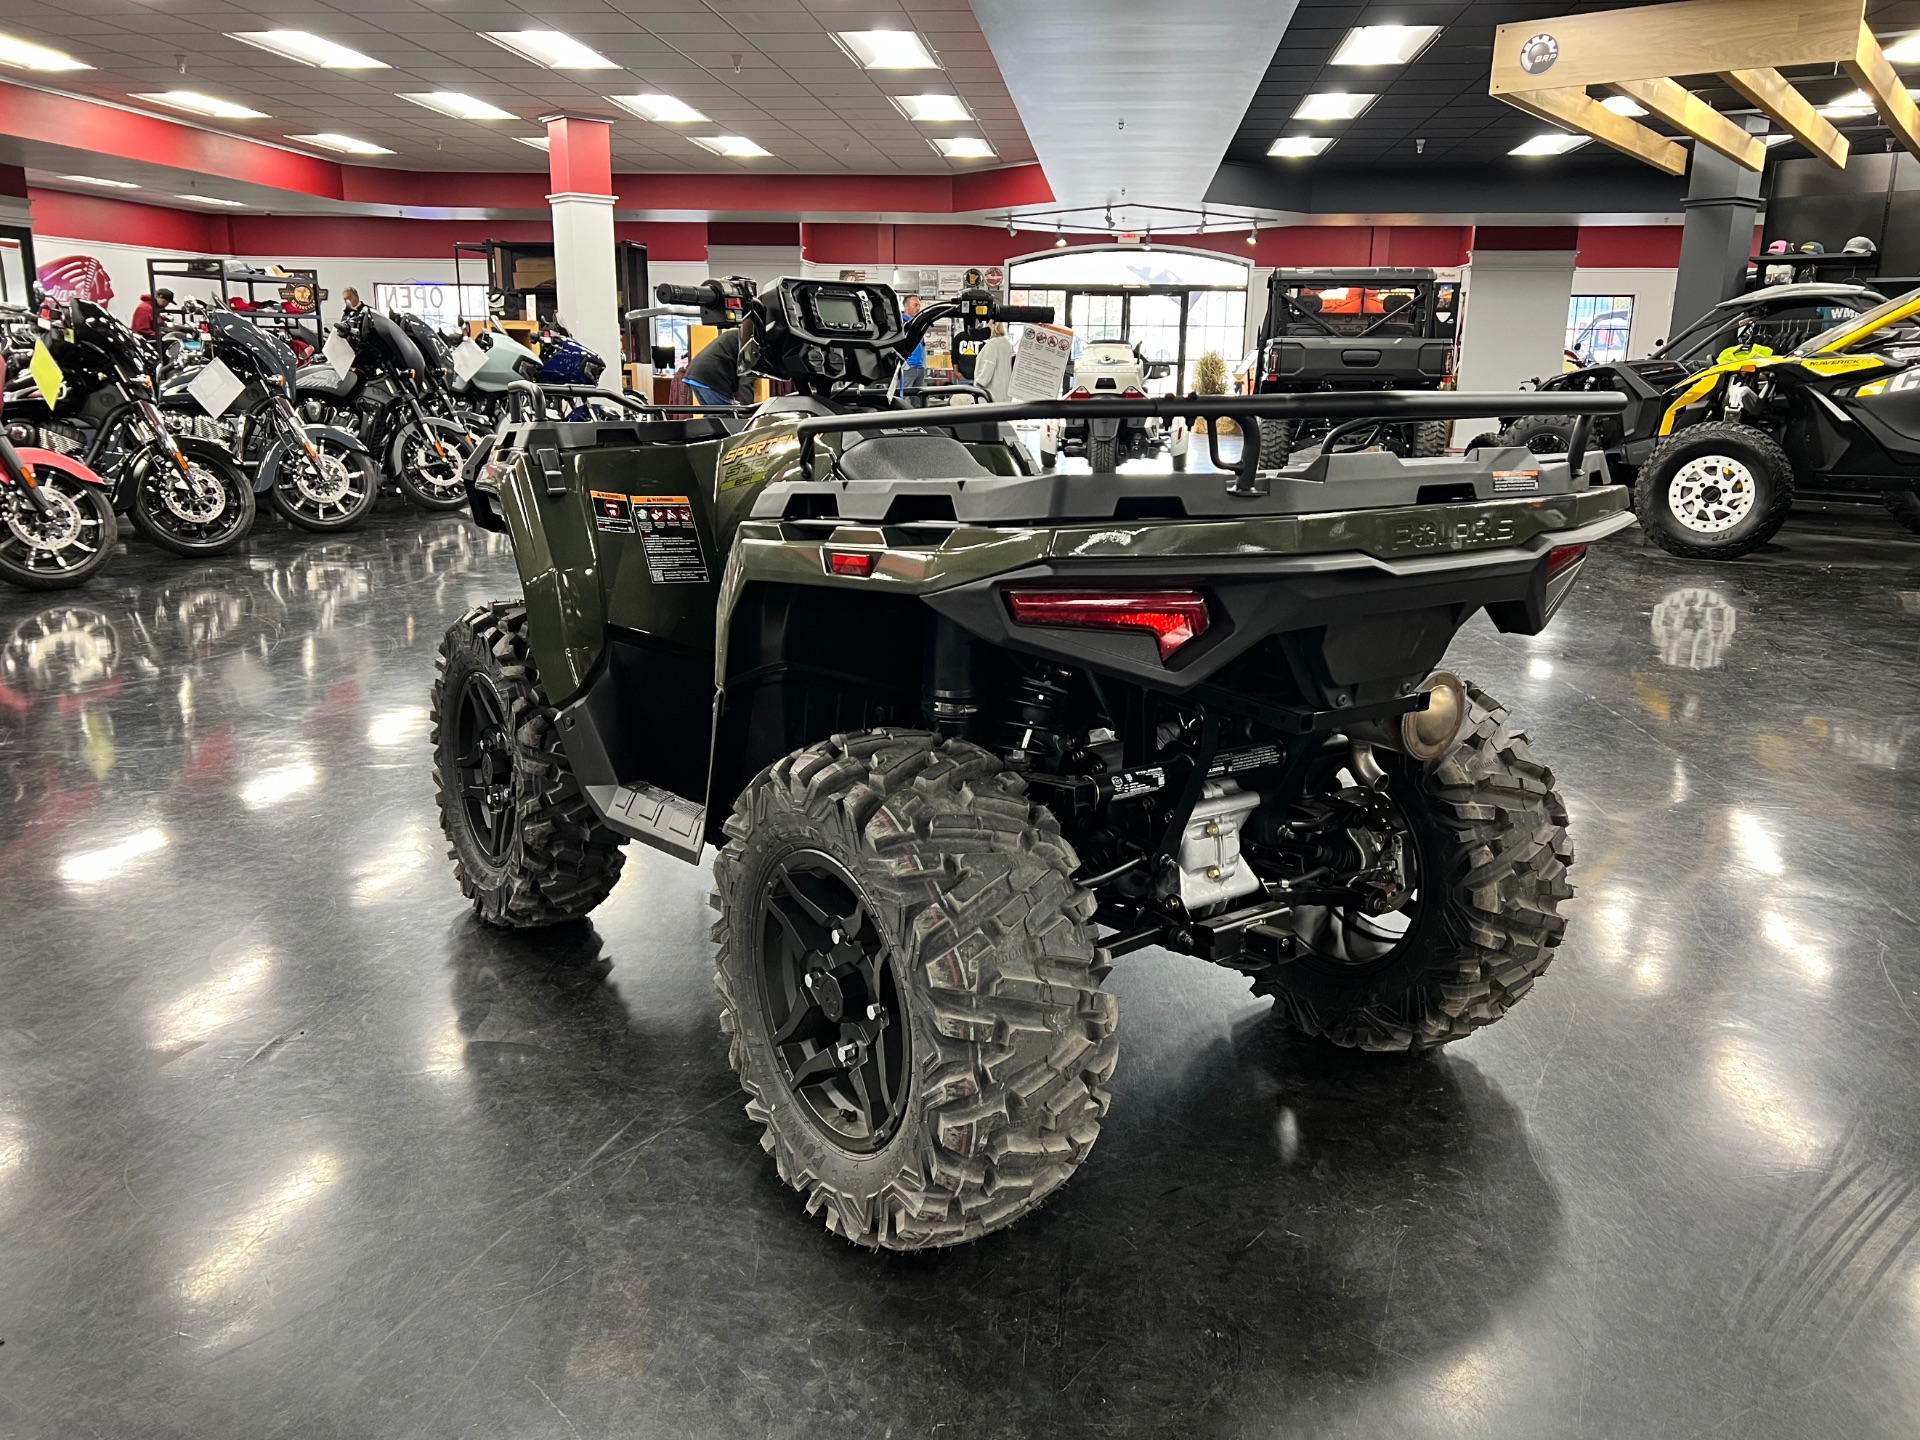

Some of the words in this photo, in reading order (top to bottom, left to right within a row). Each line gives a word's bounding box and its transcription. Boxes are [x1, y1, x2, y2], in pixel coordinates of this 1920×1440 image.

[1534, 54, 1557, 63] BRP
[959, 340, 983, 355] CAT
[1392, 519, 1514, 550] POLARIS
